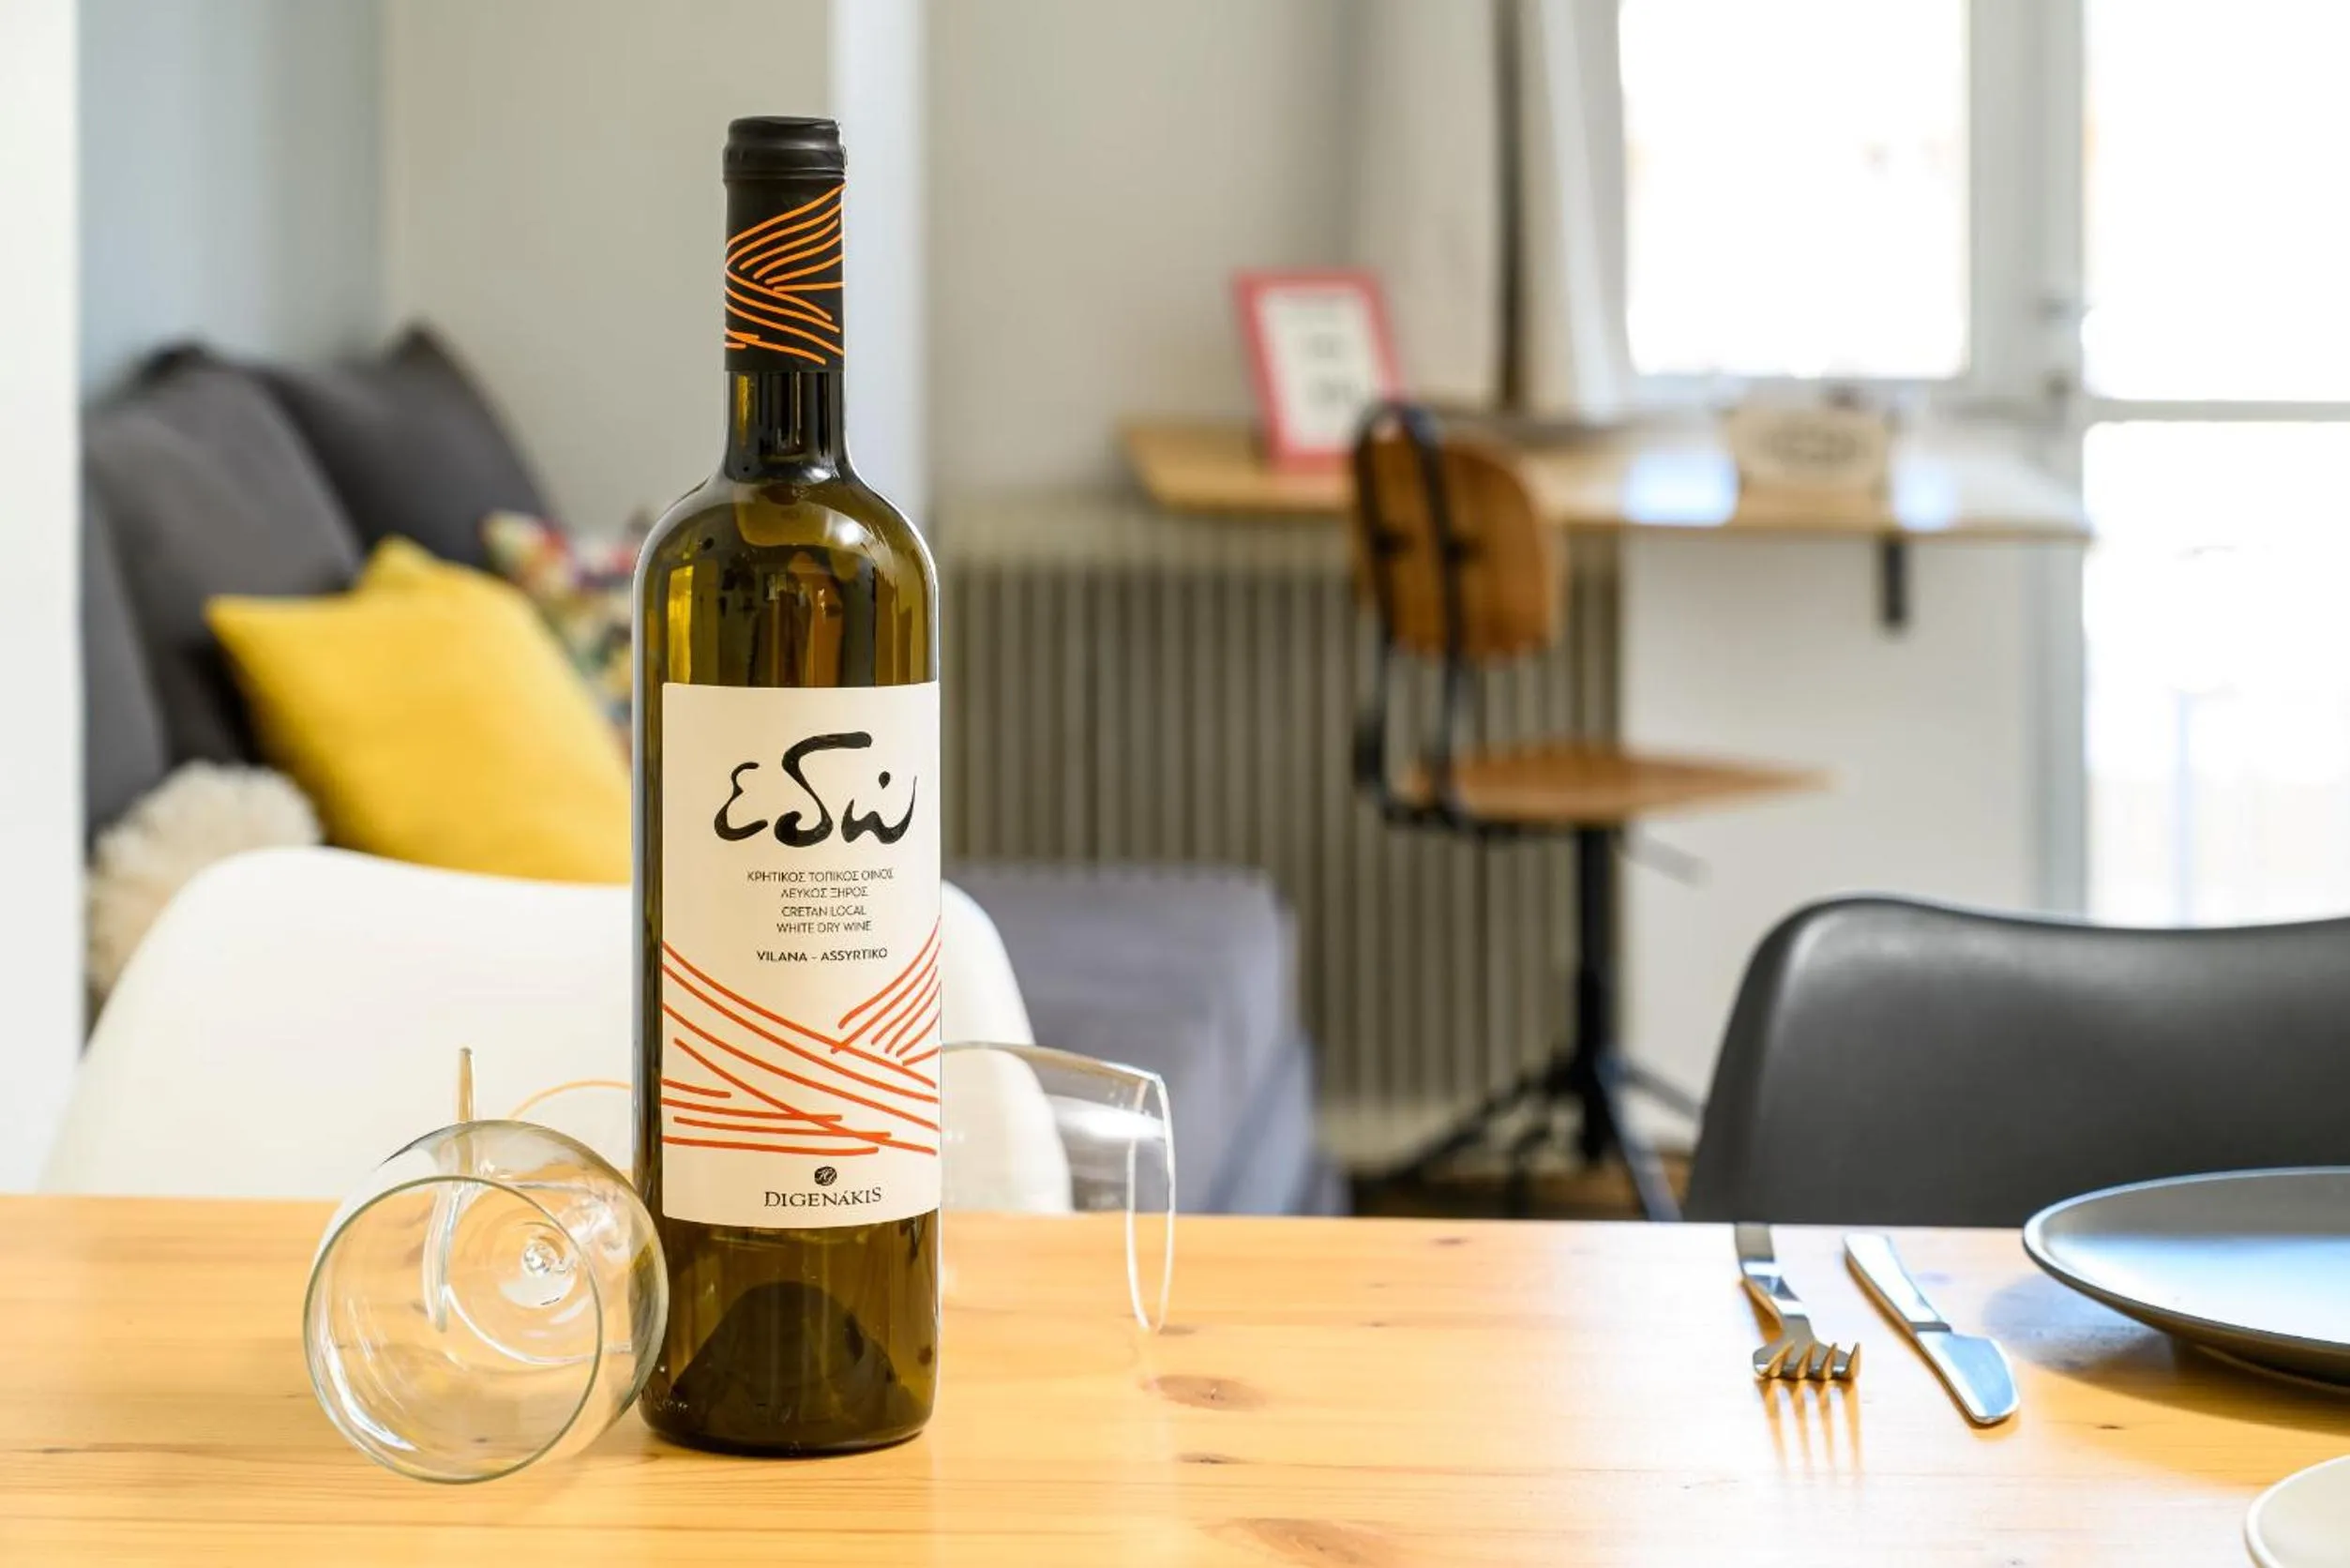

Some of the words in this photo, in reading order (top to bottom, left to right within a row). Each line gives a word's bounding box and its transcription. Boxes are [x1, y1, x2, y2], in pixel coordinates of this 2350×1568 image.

[746, 870, 806, 882] ΚΡΗΤΙΚΟΣ
[808, 869, 860, 882] ΤΟΠΙΚΟΣ
[861, 867, 894, 880] ΟΙΝΟΣ
[781, 887, 828, 898] ΛΕΥΚΟΣ
[830, 885, 868, 897] ΞΗΡΟΣ
[781, 905, 828, 917] CRETAN
[830, 904, 867, 917] LOCAL
[776, 922, 815, 934] WHITE
[817, 921, 840, 933] DRY
[842, 920, 872, 932] WINE
[757, 950, 807, 962] VILANA
[821, 947, 888, 962] ASSYRTIKO
